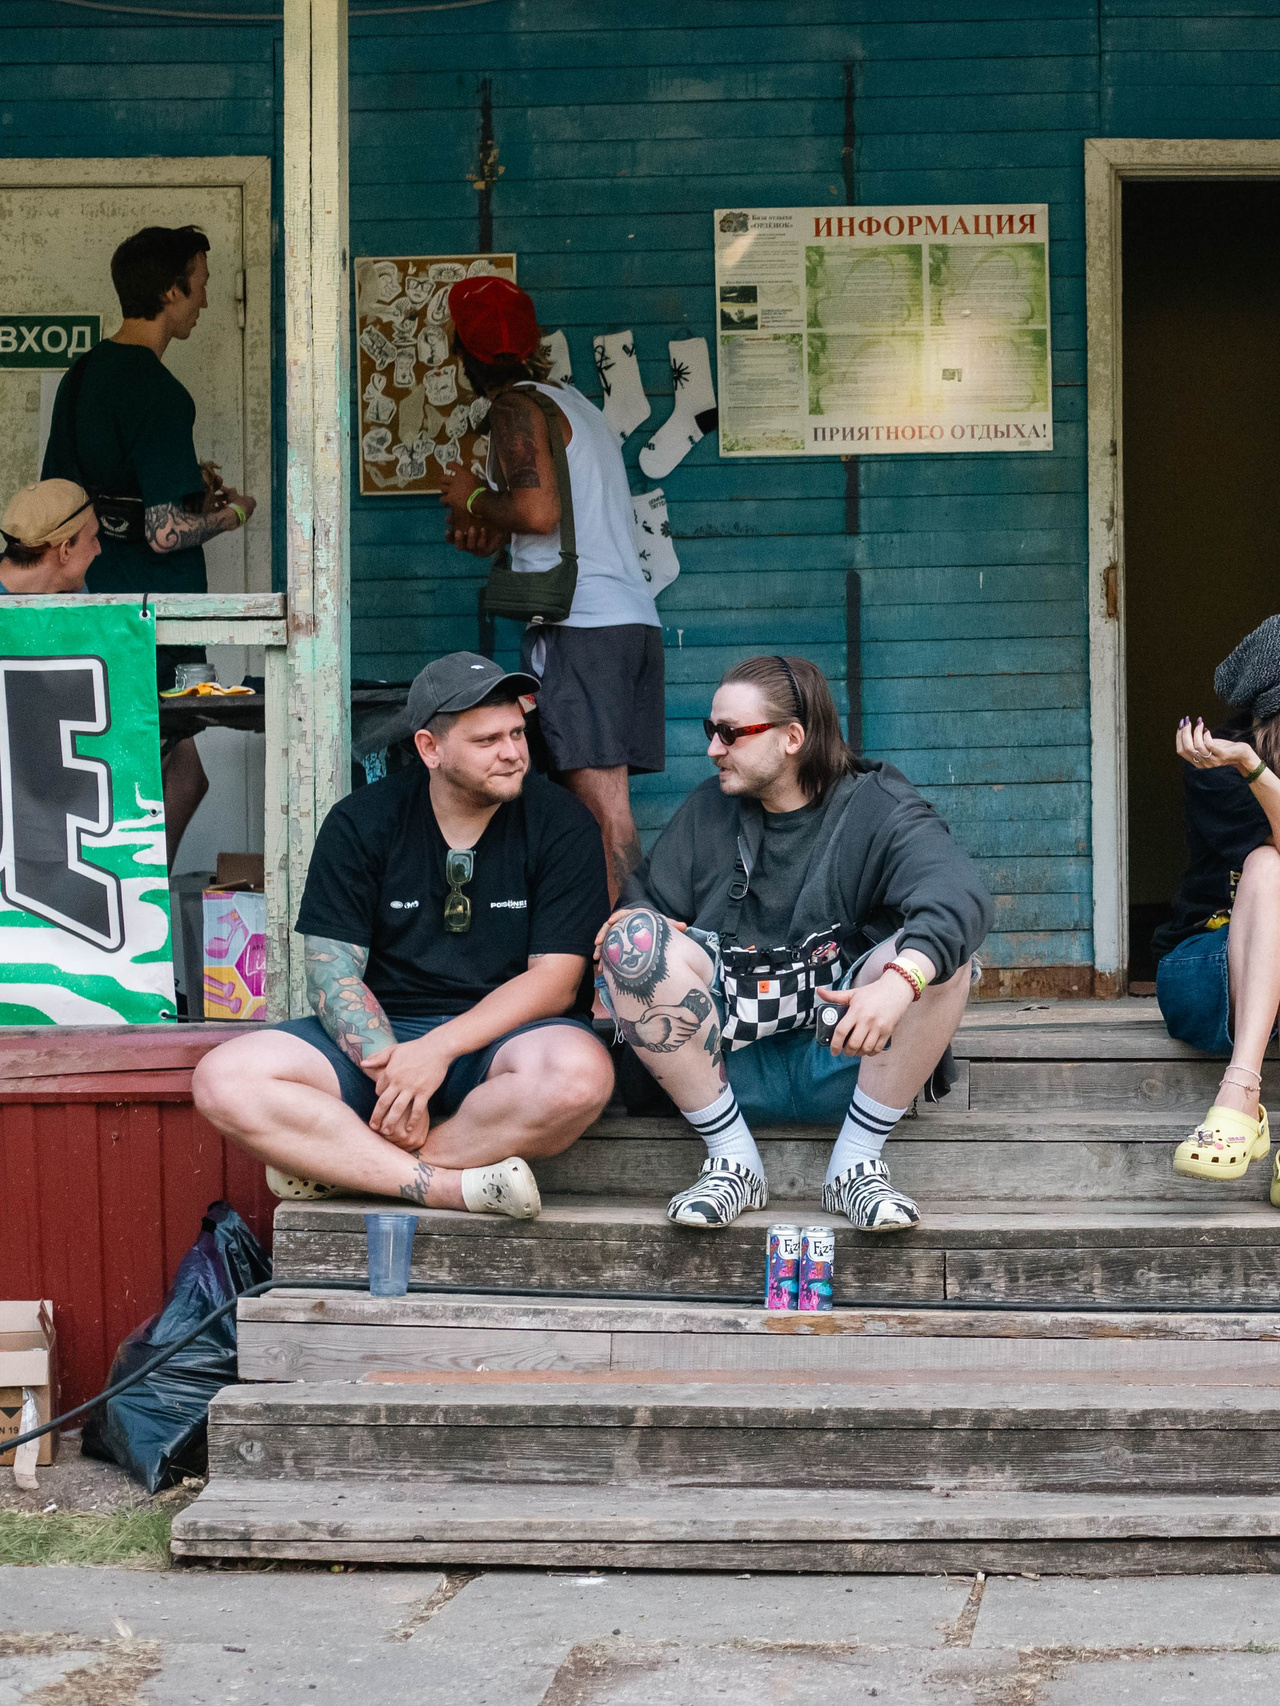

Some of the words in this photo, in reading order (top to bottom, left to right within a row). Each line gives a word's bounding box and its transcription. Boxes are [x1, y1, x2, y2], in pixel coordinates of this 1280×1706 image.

[813, 213, 1036, 239] ИНФОРМАЦИЯ
[0, 325, 92, 358] ВХОД
[813, 424, 944, 442] ПРИЯТНОГО
[950, 423, 1047, 442] ОТДЫХА!
